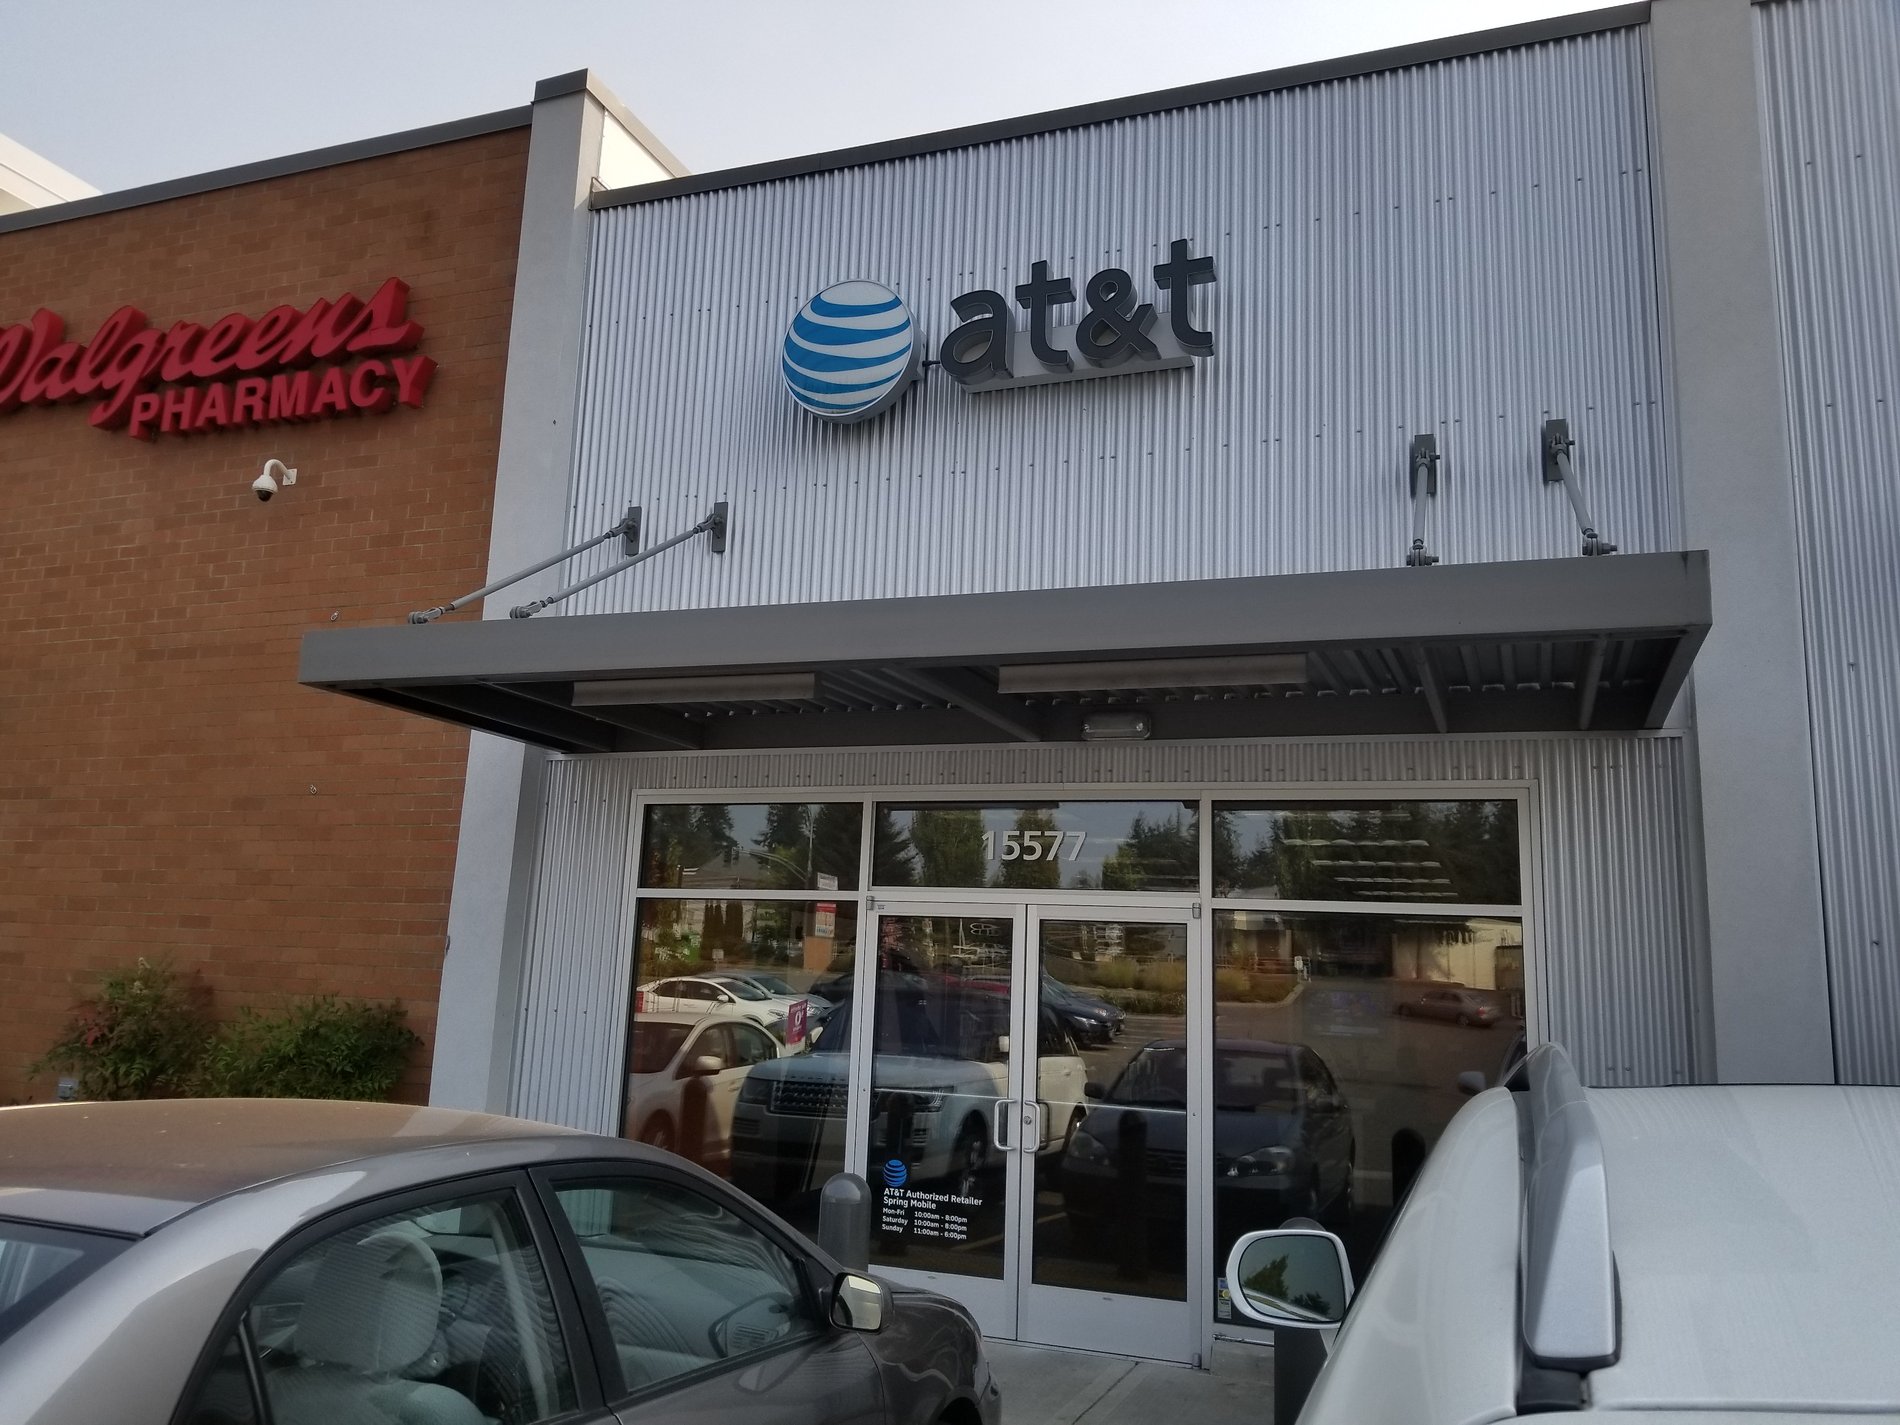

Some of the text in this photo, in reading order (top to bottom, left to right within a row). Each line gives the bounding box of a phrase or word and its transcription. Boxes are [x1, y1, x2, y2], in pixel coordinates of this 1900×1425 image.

[940, 238, 1217, 386] at&t
[129, 356, 438, 440] PHARMACY
[981, 830, 1087, 861] 15577
[883, 1187, 983, 1206] AT&T Authorized Retailer
[883, 1196, 937, 1210] Spring Mobile
[882, 1207, 905, 1216] Mon-Fri
[914, 1211, 940, 1220] 10:00am
[945, 1215, 968, 1223] 8:00pm
[882, 1215, 909, 1226] Saturday
[914, 1219, 940, 1228] 10:00am
[882, 1223, 904, 1233] Sunday
[913, 1227, 939, 1237] 11:00am
